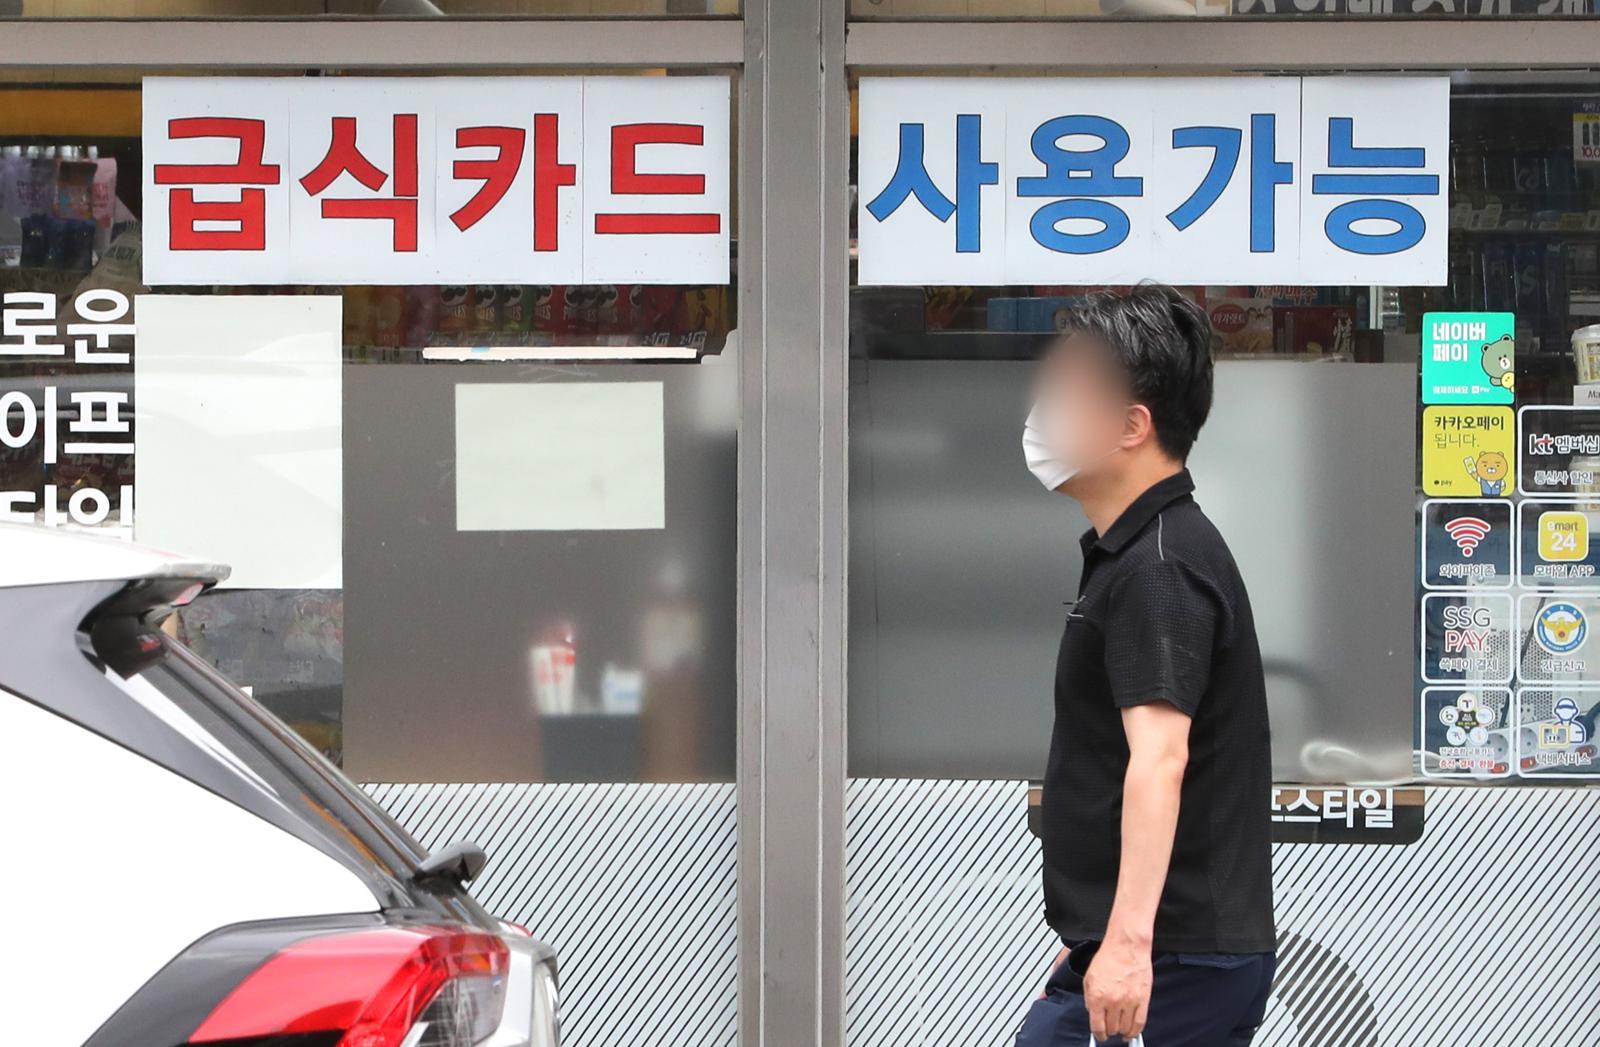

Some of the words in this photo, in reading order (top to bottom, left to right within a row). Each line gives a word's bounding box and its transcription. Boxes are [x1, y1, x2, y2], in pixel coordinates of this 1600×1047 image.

[153, 113, 721, 252] 급식카드
[865, 113, 1440, 255] 사용가능
[0, 289, 136, 363] 로운
[1432, 322, 1486, 341] 네이버
[1432, 343, 1468, 362] 페이
[0, 386, 135, 464] 이프
[1434, 416, 1504, 431] 카카오페이
[1433, 433, 1480, 449] 됩니다.
[1529, 434, 1554, 455] kt
[1555, 435, 1600, 454] 멤버십
[1534, 470, 1569, 485] 통신사
[1570, 470, 1594, 485] 할인
[1551, 532, 1577, 552] 24
[1439, 563, 1496, 578] 와이파이존
[1533, 564, 1568, 578] 모바일
[1568, 564, 1595, 578] APP
[1443, 606, 1491, 629] SSG
[1540, 658, 1586, 673] 긴급신고
[1536, 751, 1592, 766] 택배서비스
